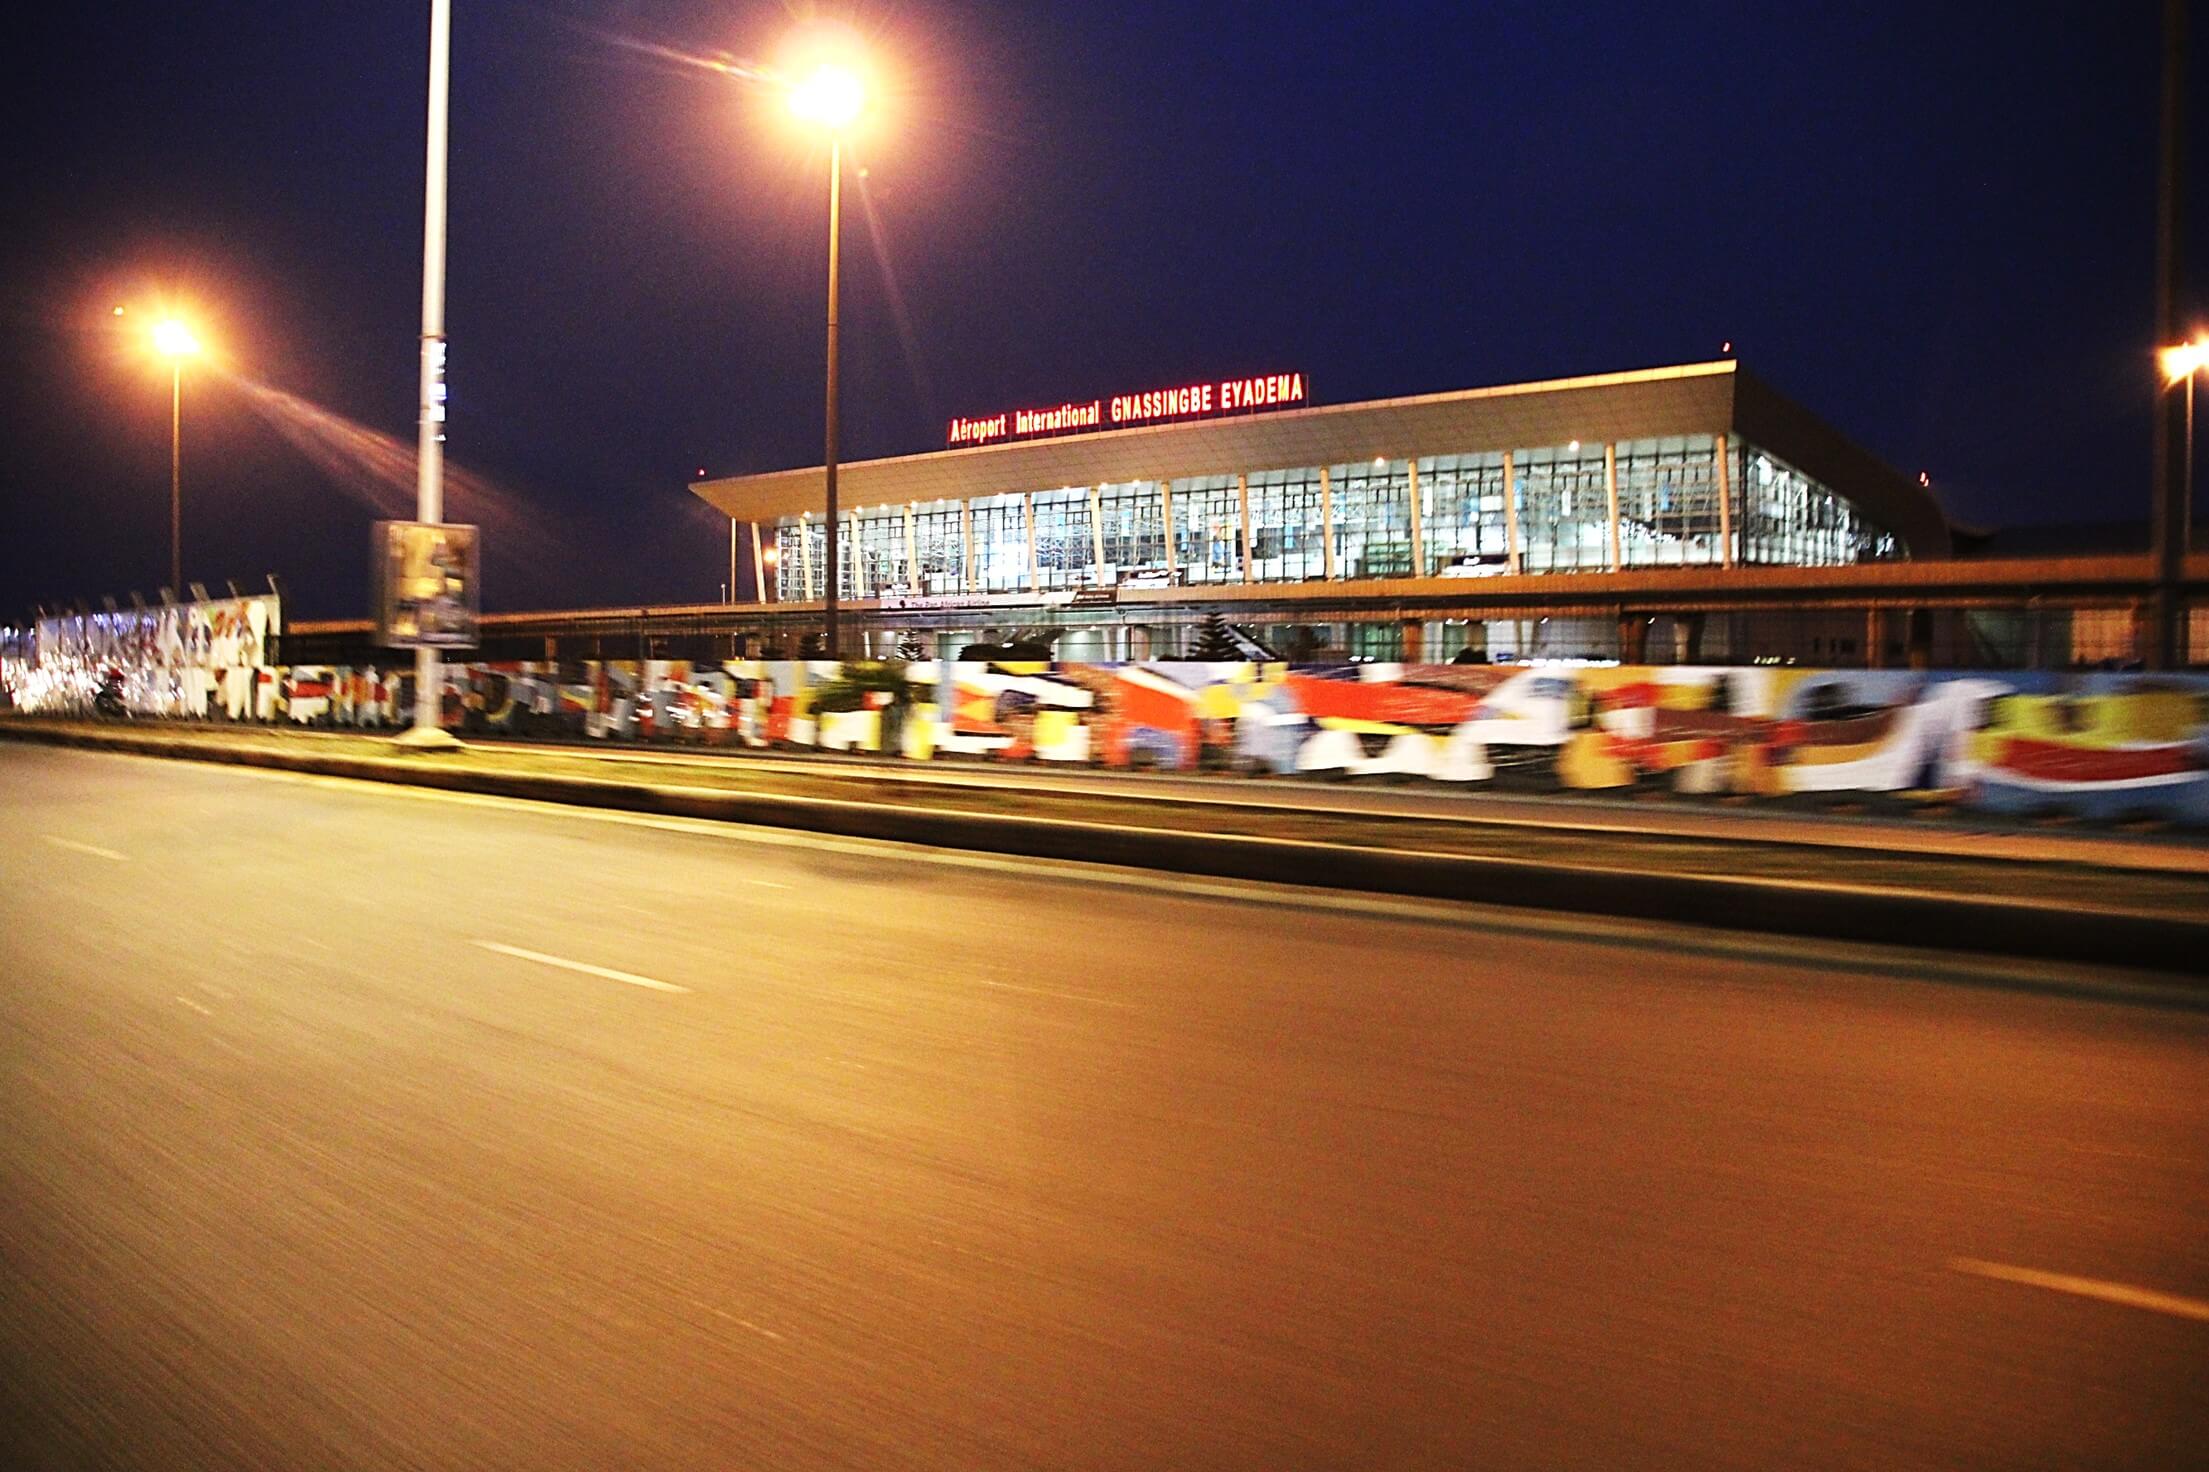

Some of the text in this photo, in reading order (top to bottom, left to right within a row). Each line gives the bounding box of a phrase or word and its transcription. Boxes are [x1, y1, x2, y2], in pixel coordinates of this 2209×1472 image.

[950, 373, 1303, 443] Aéroport International GNASSINGBE EYADEMA
